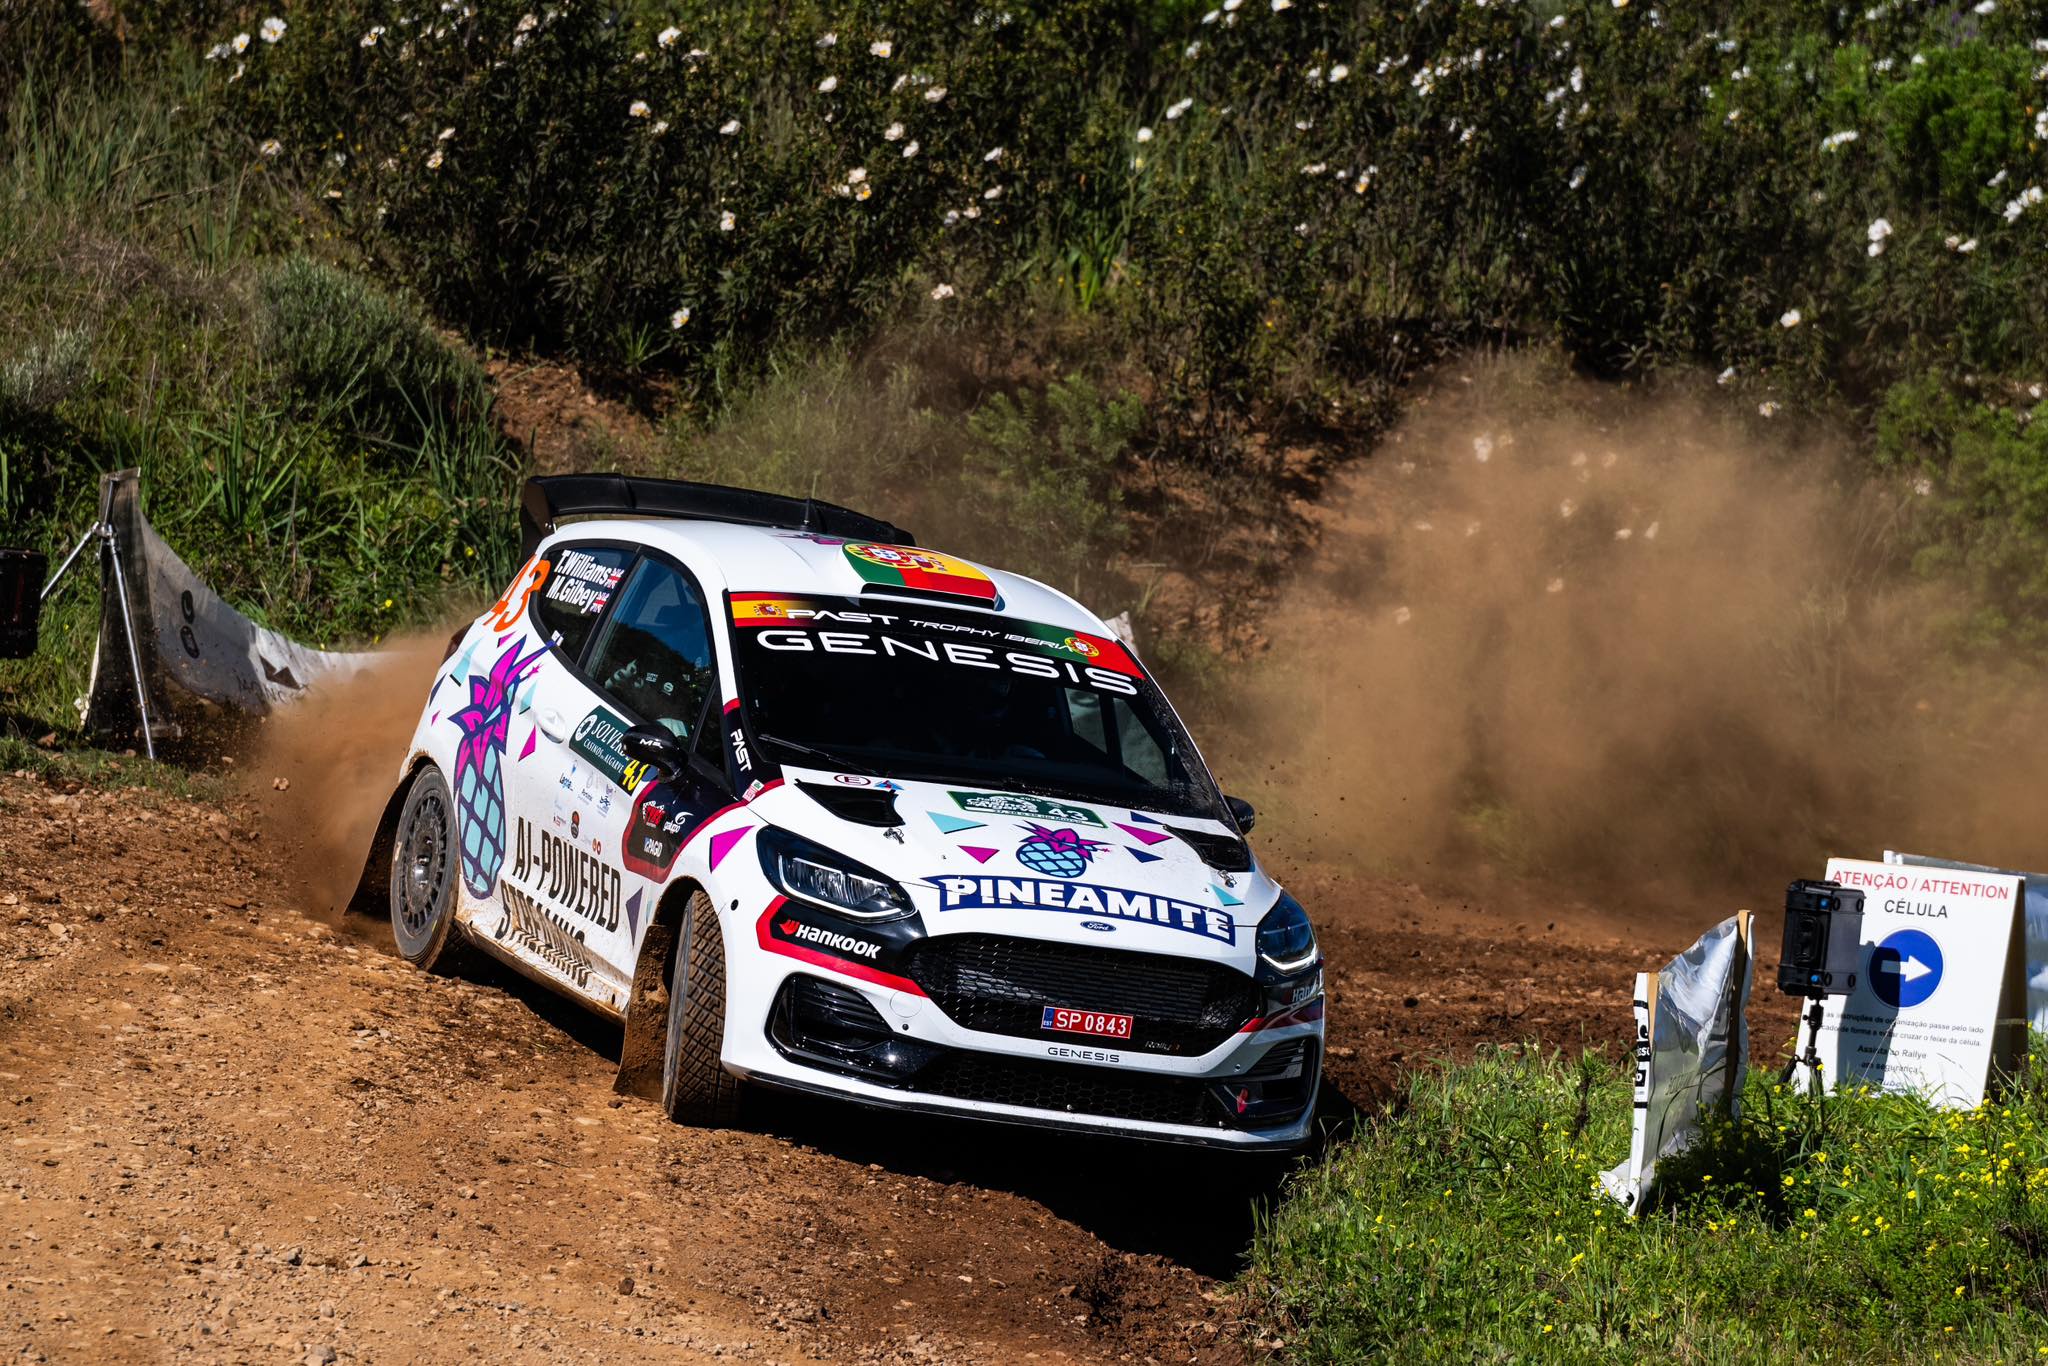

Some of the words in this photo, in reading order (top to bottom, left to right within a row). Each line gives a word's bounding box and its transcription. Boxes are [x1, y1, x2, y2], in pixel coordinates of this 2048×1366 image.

[554, 549, 612, 587] T.Williams
[546, 575, 598, 614] M.Gilbey
[786, 609, 899, 625] PAST
[909, 620, 1000, 637] TROPHY
[1004, 633, 1074, 652] IBERIA
[757, 630, 1138, 695] GENESIS
[730, 728, 752, 772] PAST
[1048, 807, 1089, 821] 43
[512, 816, 621, 933] AI-POWERED
[1832, 870, 1908, 891] ATENÇÃO
[1920, 878, 2009, 900] ATTENTION
[940, 876, 1231, 940] PINEAMITE
[1884, 898, 1948, 918] CÉLULA
[1056, 1011, 1081, 1029] SP
[1084, 1014, 1127, 1035] 0843
[1047, 1047, 1120, 1063] GENESIS
[1902, 1049, 1927, 1060] Rallye
